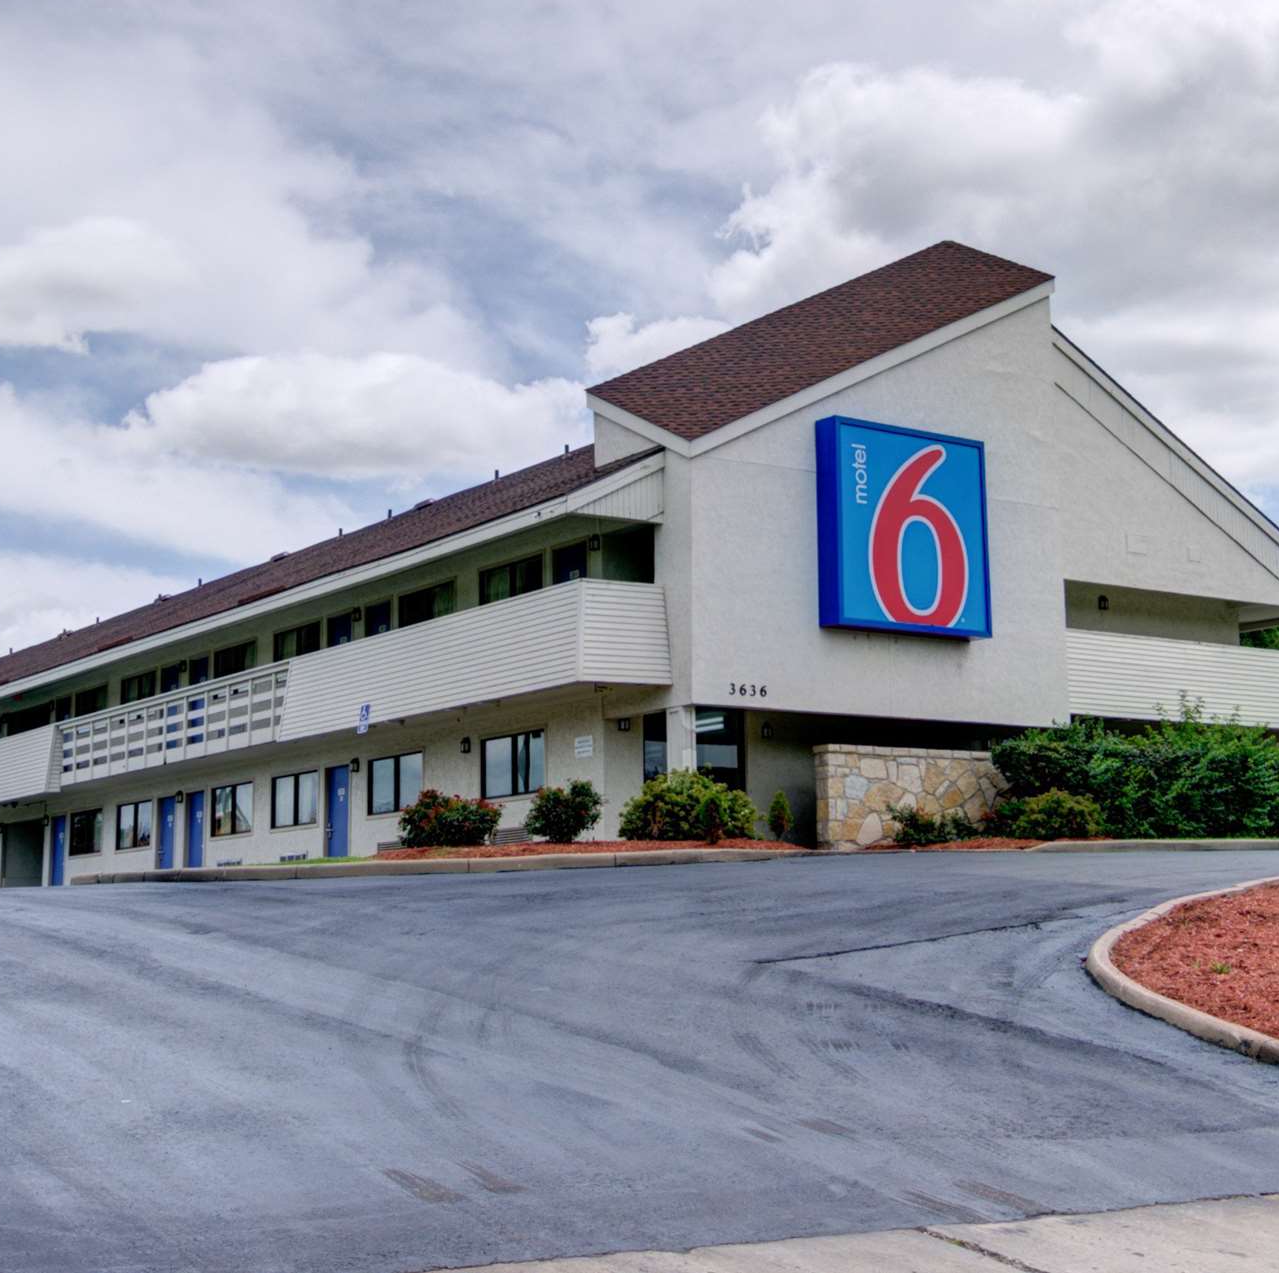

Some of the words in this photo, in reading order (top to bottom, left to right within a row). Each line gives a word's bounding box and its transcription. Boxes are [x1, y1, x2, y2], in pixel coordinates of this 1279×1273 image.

[851, 443, 868, 505] motel
[868, 444, 969, 628] 6
[728, 683, 768, 697] 3636
